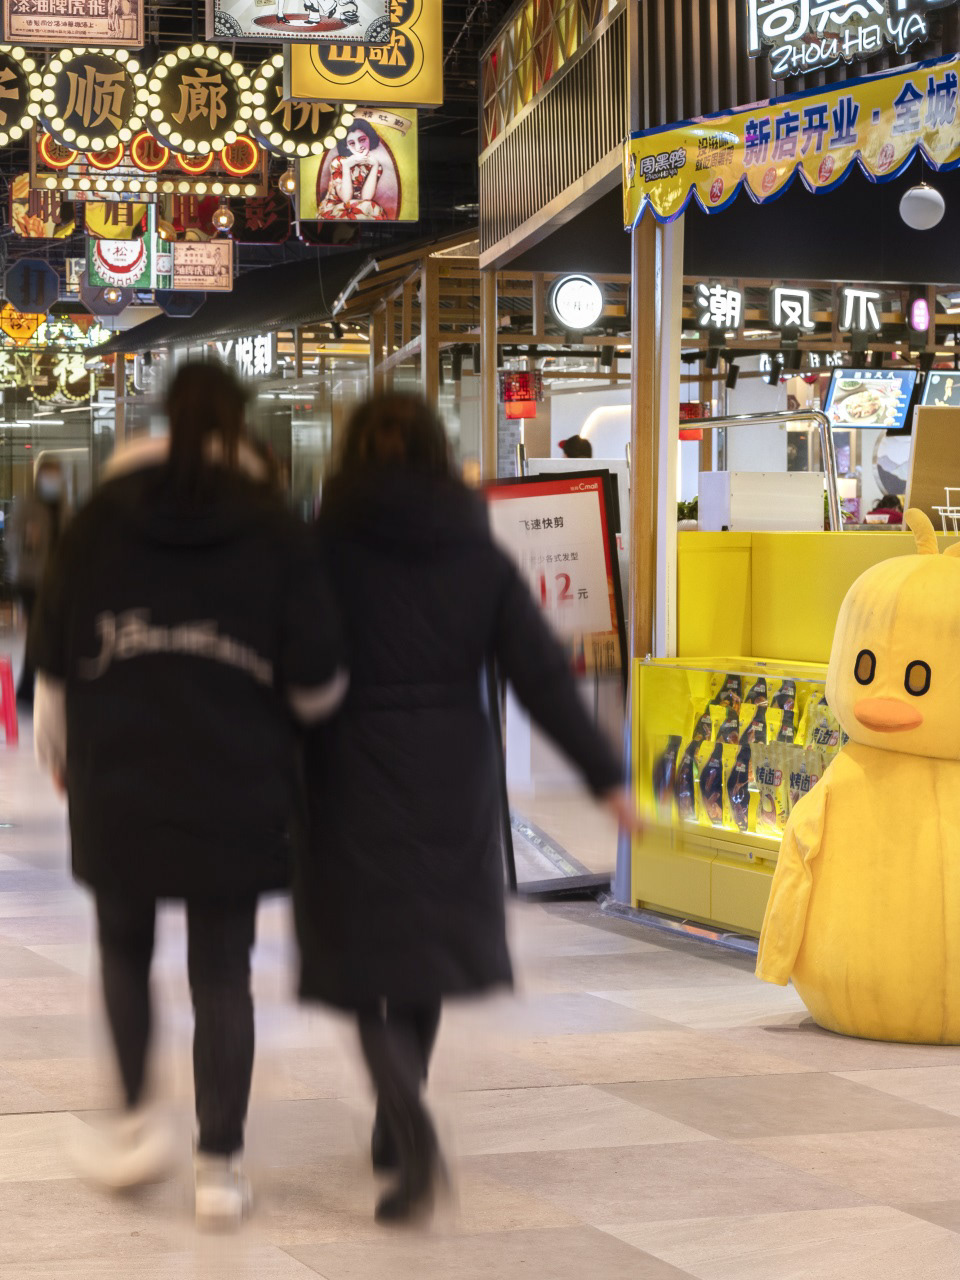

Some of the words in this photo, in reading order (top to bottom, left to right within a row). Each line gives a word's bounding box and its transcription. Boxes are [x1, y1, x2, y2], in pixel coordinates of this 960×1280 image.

[772, 39, 837, 73] ZHOU
[842, 24, 882, 56] HEI
[886, 14, 927, 47] YA
[640, 147, 687, 178] 周黑鸭
[519, 516, 565, 531] 飞速快剪
